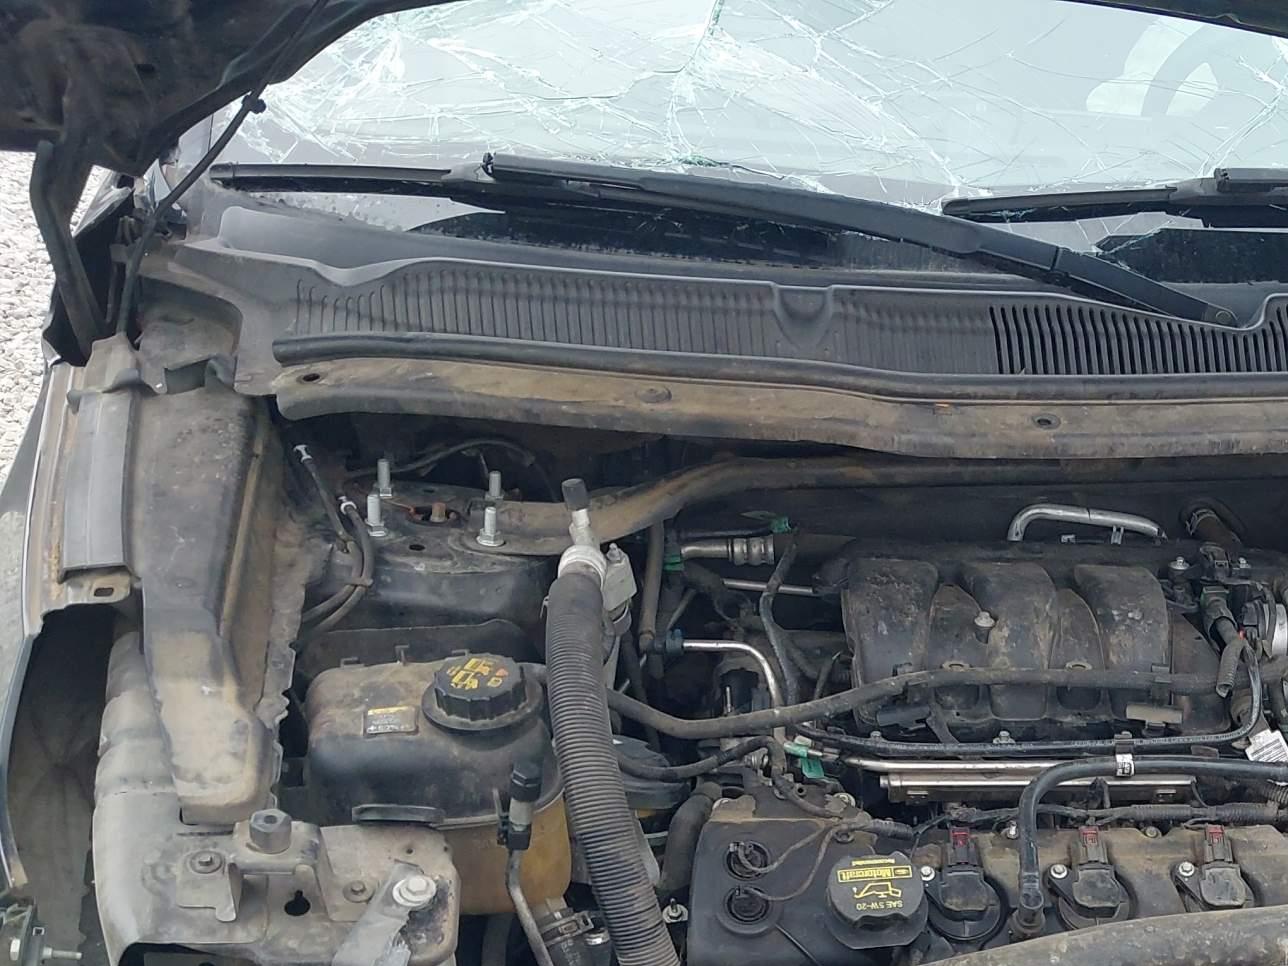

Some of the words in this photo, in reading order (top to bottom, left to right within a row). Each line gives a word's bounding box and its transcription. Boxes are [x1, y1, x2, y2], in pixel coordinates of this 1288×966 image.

[841, 868, 891, 880] Motorcraft
[856, 901, 885, 911] 5W-20
[886, 900, 903, 909] SAE
